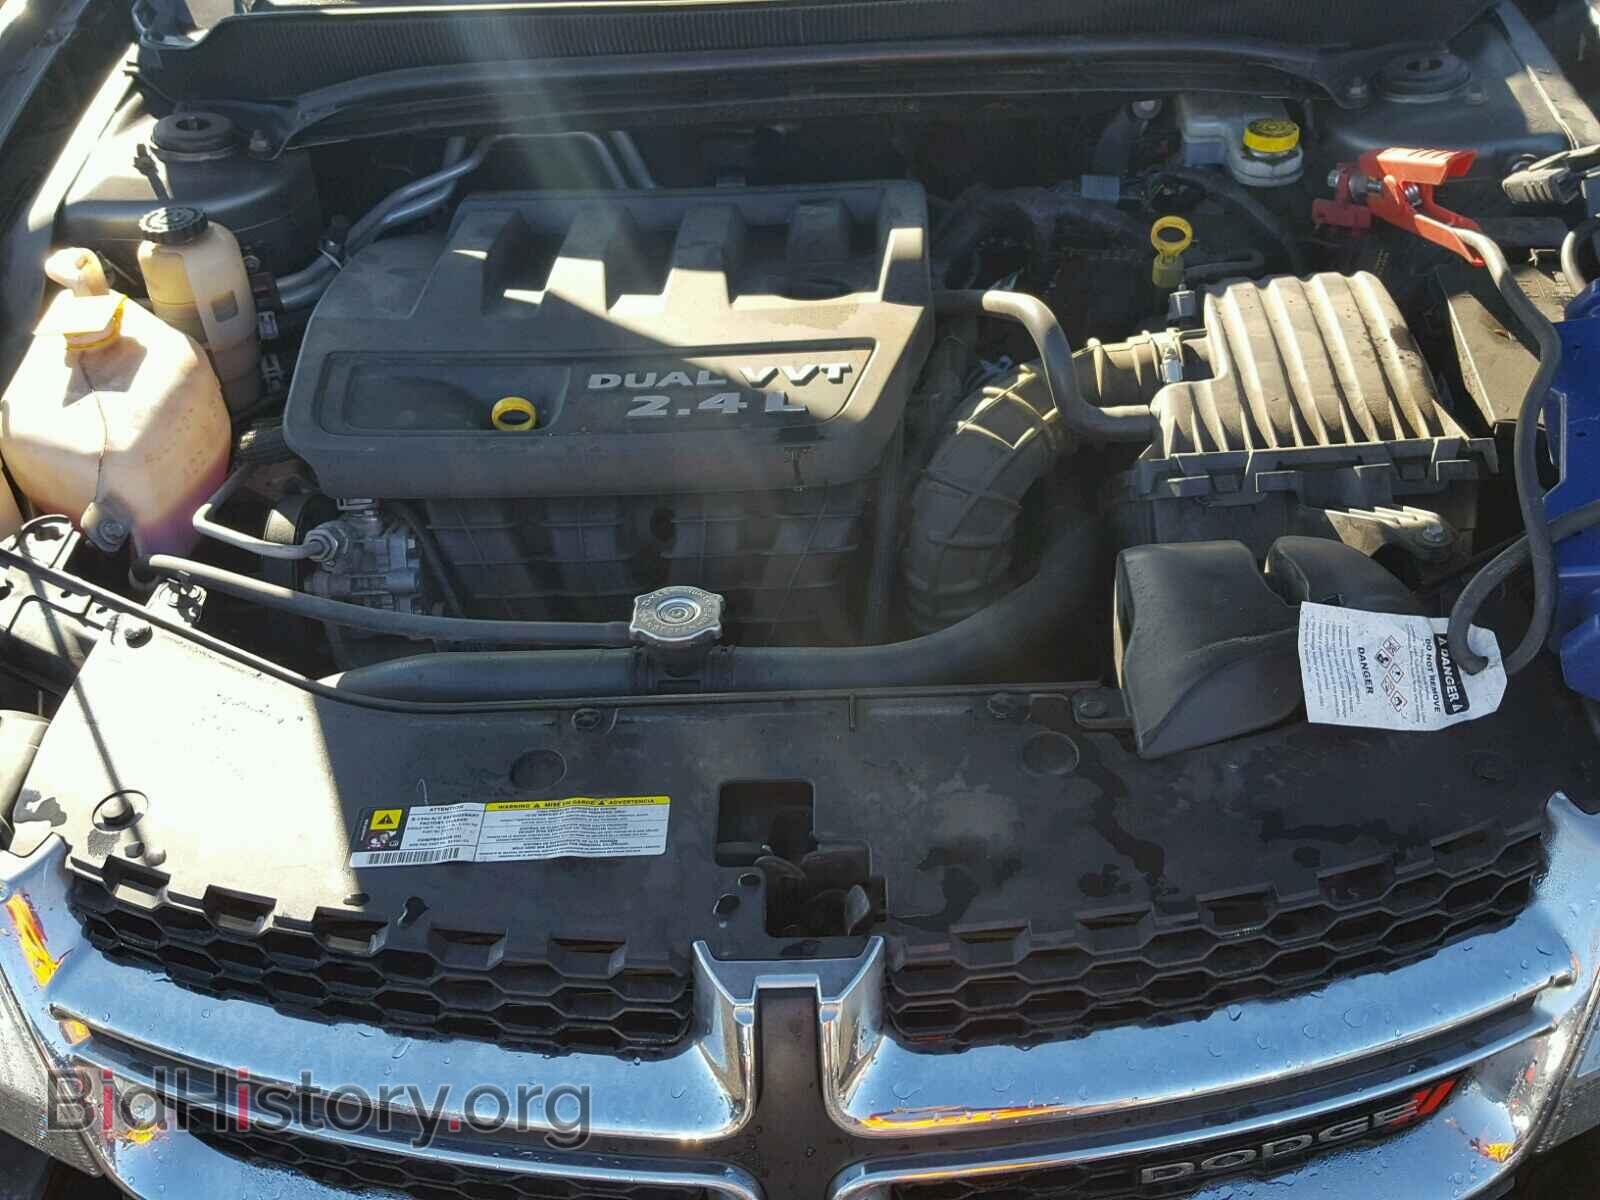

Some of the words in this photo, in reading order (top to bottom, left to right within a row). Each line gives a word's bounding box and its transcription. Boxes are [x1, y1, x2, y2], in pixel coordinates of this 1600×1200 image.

[587, 369, 727, 389] DUAL
[739, 363, 852, 389] VVT
[625, 392, 748, 417] 2.4
[764, 391, 808, 413] L
[1424, 638, 1433, 652] DO
[1357, 647, 1374, 694] DANGER
[1425, 654, 1435, 673] NOT
[1441, 648, 1460, 701] DANGER
[1428, 675, 1441, 713] REMOVE
[1141, 1099, 1420, 1184] DODGE
